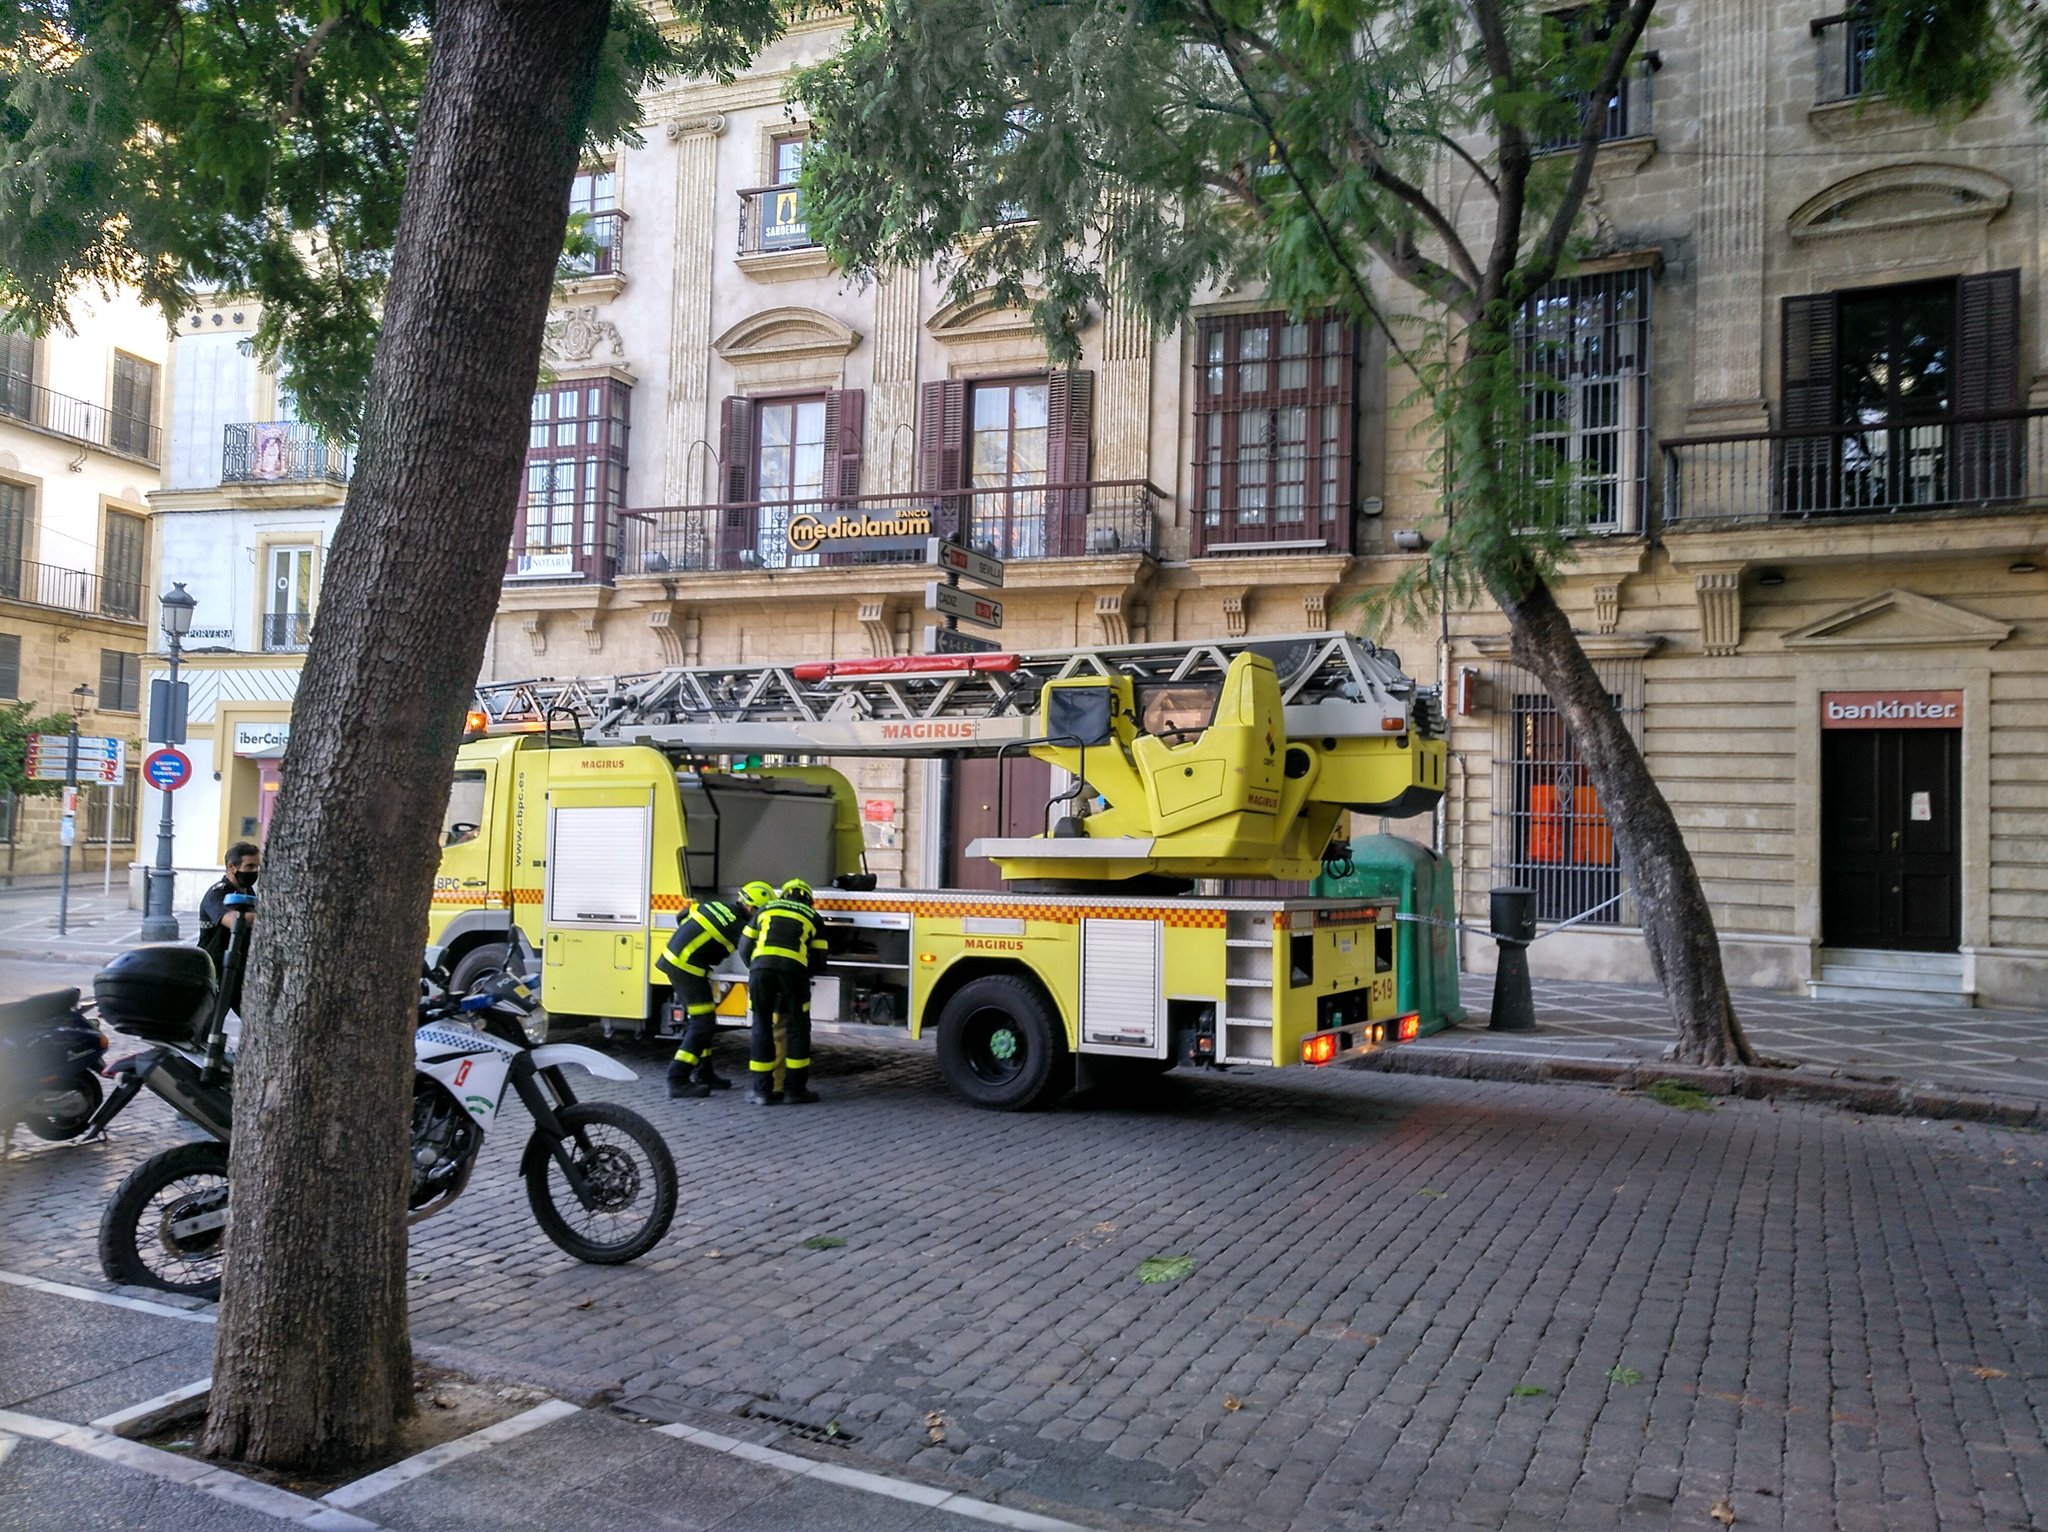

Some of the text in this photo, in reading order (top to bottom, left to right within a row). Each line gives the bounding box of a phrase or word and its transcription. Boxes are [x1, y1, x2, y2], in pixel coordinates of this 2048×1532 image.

[765, 223, 806, 237] SANDEMAN
[896, 509, 928, 518] BANCO
[792, 514, 930, 540] mediolanum
[979, 562, 1001, 578] SEVILLA
[884, 723, 972, 739] MAGIRUS
[581, 760, 625, 769] MAGIRUS
[1247, 793, 1278, 809] MAGIRUS
[516, 771, 525, 867] www.cbpc.es
[964, 939, 1024, 951] MAGIRUS
[1372, 978, 1393, 1002] E-19
